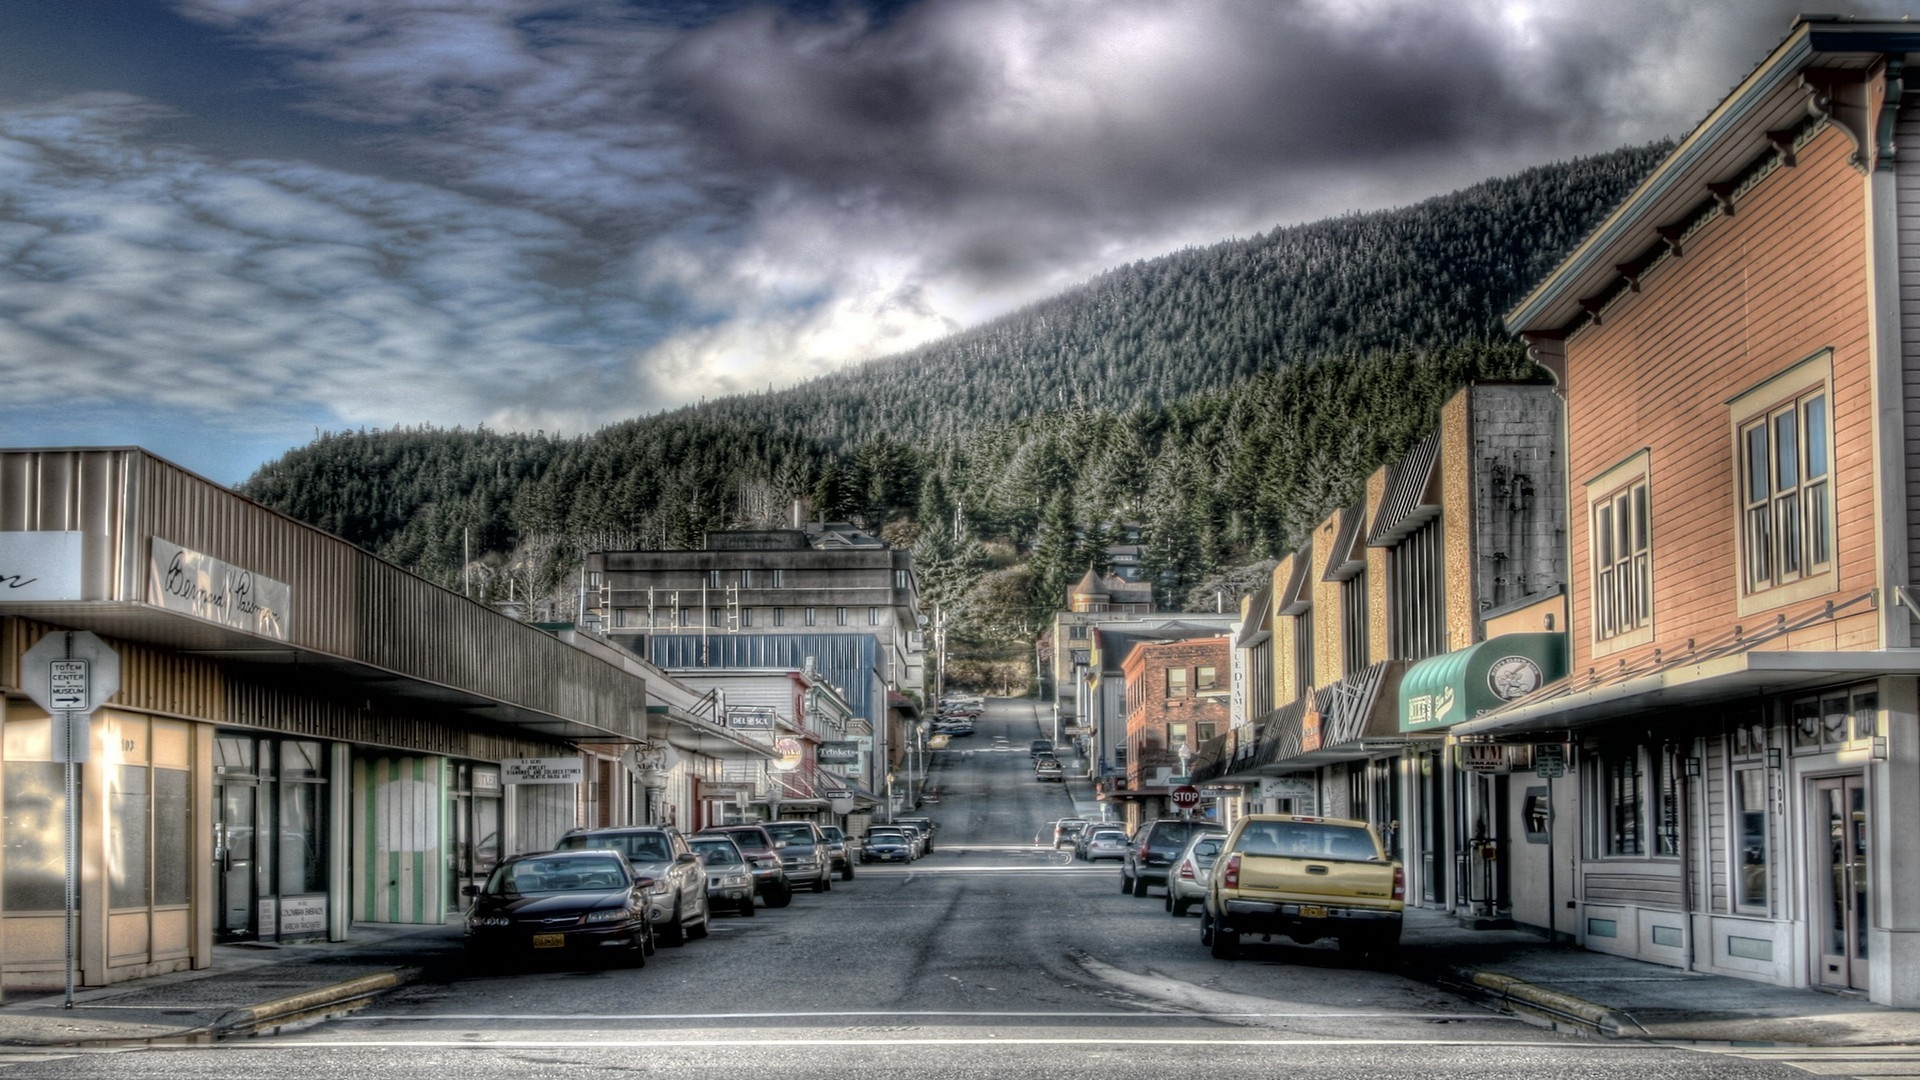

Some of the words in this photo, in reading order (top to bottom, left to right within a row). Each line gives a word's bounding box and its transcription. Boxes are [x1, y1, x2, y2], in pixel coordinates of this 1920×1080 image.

[733, 717, 746, 725] DEL
[755, 717, 768, 725] SOL
[820, 748, 856, 758] Trinkets
[1466, 745, 1502, 760] ATM
[1173, 792, 1199, 802] STOP
